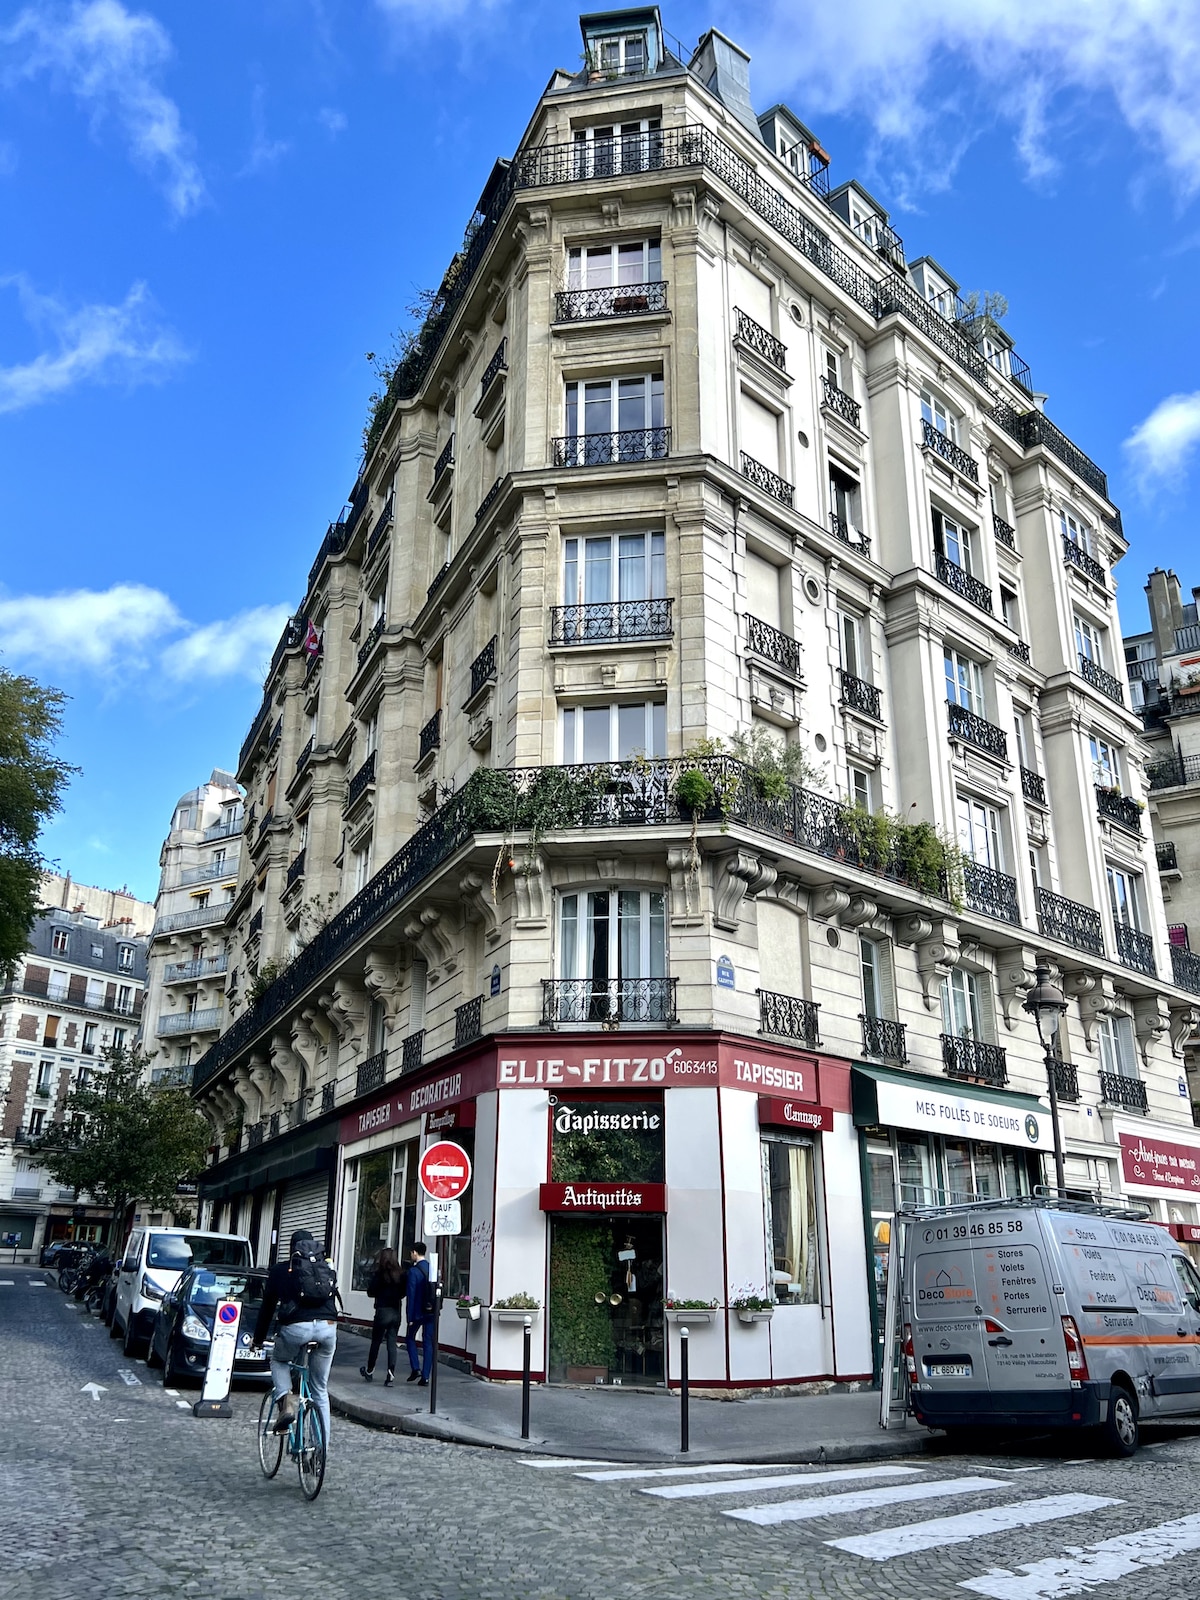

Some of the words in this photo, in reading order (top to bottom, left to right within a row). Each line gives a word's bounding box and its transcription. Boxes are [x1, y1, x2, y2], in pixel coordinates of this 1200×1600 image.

[499, 1059, 564, 1083] ELIE
[582, 1058, 666, 1083] FITZO
[673, 1060, 718, 1075] 6063413
[734, 1060, 803, 1091] TAPISSIER
[358, 1103, 391, 1133] TAPISSIER
[410, 1073, 461, 1112] DECORATEUR
[555, 1106, 660, 1135] Tapisserie
[783, 1103, 822, 1128] Cannage
[916, 1100, 936, 1117] MES
[939, 1105, 971, 1123] FOLLES
[974, 1112, 985, 1126] DE
[988, 1114, 1020, 1132] SOEURS
[562, 1186, 642, 1209] Antiquités
[433, 1204, 452, 1212] SAUF
[936, 1228, 948, 1240] 01
[953, 1226, 967, 1238] 39
[970, 1224, 984, 1236] 46
[988, 1222, 1003, 1234] 85
[1007, 1220, 1023, 1232] 58
[1075, 1228, 1097, 1240] Stores
[1119, 1232, 1126, 1242] 01
[998, 1250, 1023, 1259] Stores
[1081, 1248, 1102, 1260] Volets
[1000, 1263, 1025, 1272] Volets
[1002, 1277, 1037, 1286] Fenêtres
[1089, 1270, 1117, 1282] Fenêtres
[919, 1287, 974, 1300] DecoStore
[1004, 1291, 1030, 1300] Portes
[1096, 1292, 1117, 1303] Portes
[1006, 1304, 1047, 1315] Serrurerie
[1103, 1315, 1134, 1327] Serrurerie
[918, 1323, 978, 1332] www.deco-store.fr
